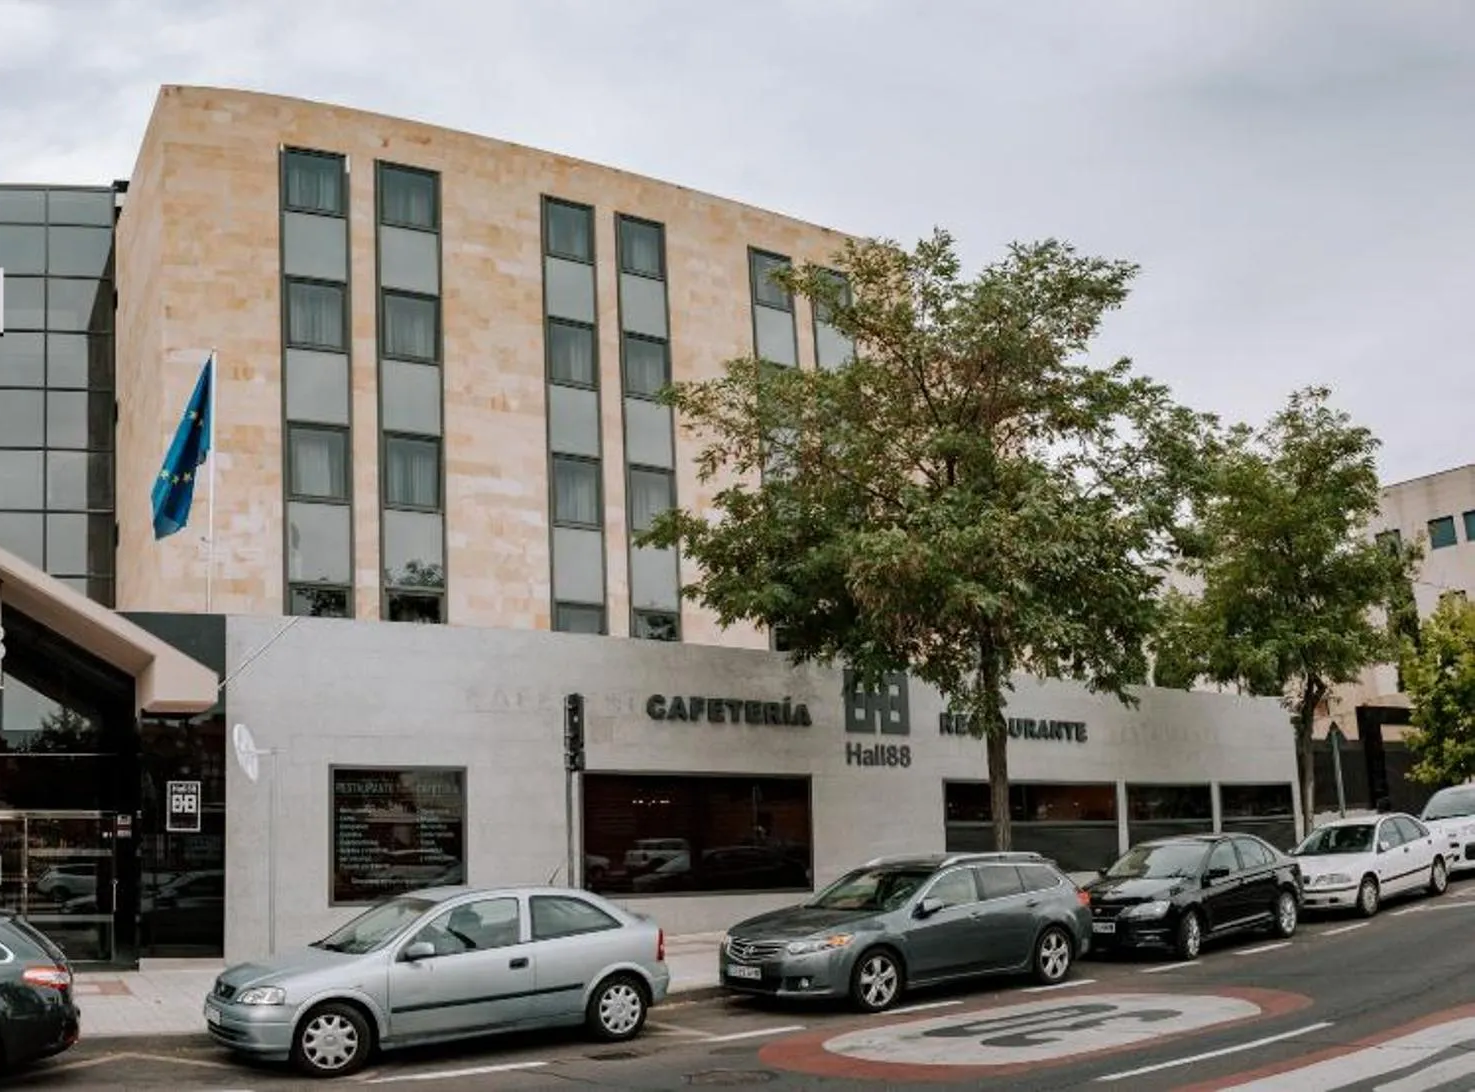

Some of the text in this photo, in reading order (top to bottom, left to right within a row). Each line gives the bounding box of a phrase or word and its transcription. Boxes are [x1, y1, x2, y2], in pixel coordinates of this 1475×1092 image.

[646, 694, 812, 726] CAFETERÍA
[939, 712, 1088, 742] REURANTE
[845, 743, 912, 767] Hall88
